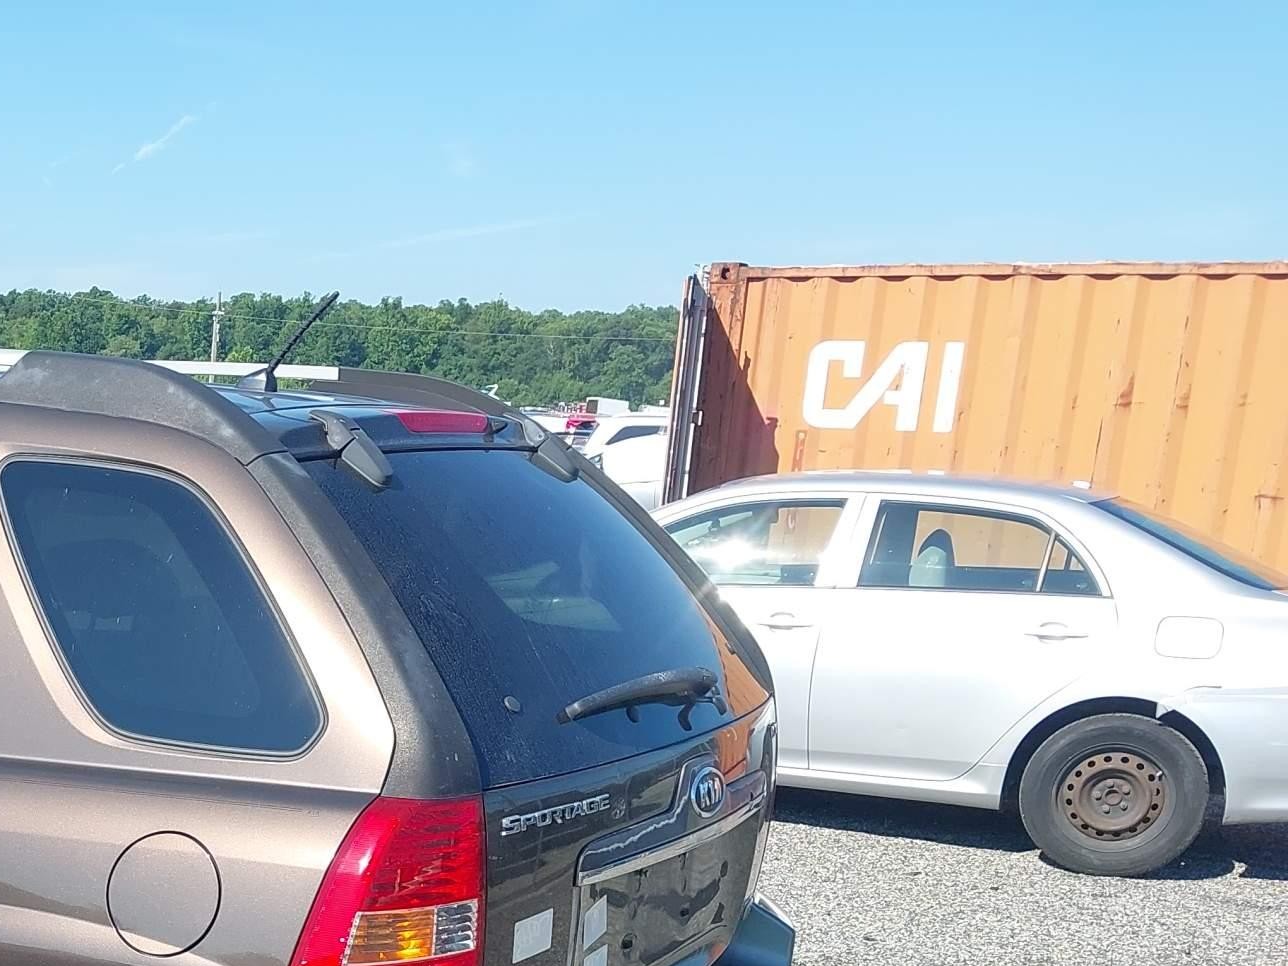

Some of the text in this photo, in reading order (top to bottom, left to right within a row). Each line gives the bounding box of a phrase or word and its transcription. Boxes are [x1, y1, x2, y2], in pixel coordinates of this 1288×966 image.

[803, 340, 965, 432] CAI
[501, 793, 611, 836] SPORTAGE
[699, 777, 721, 809] KIA
